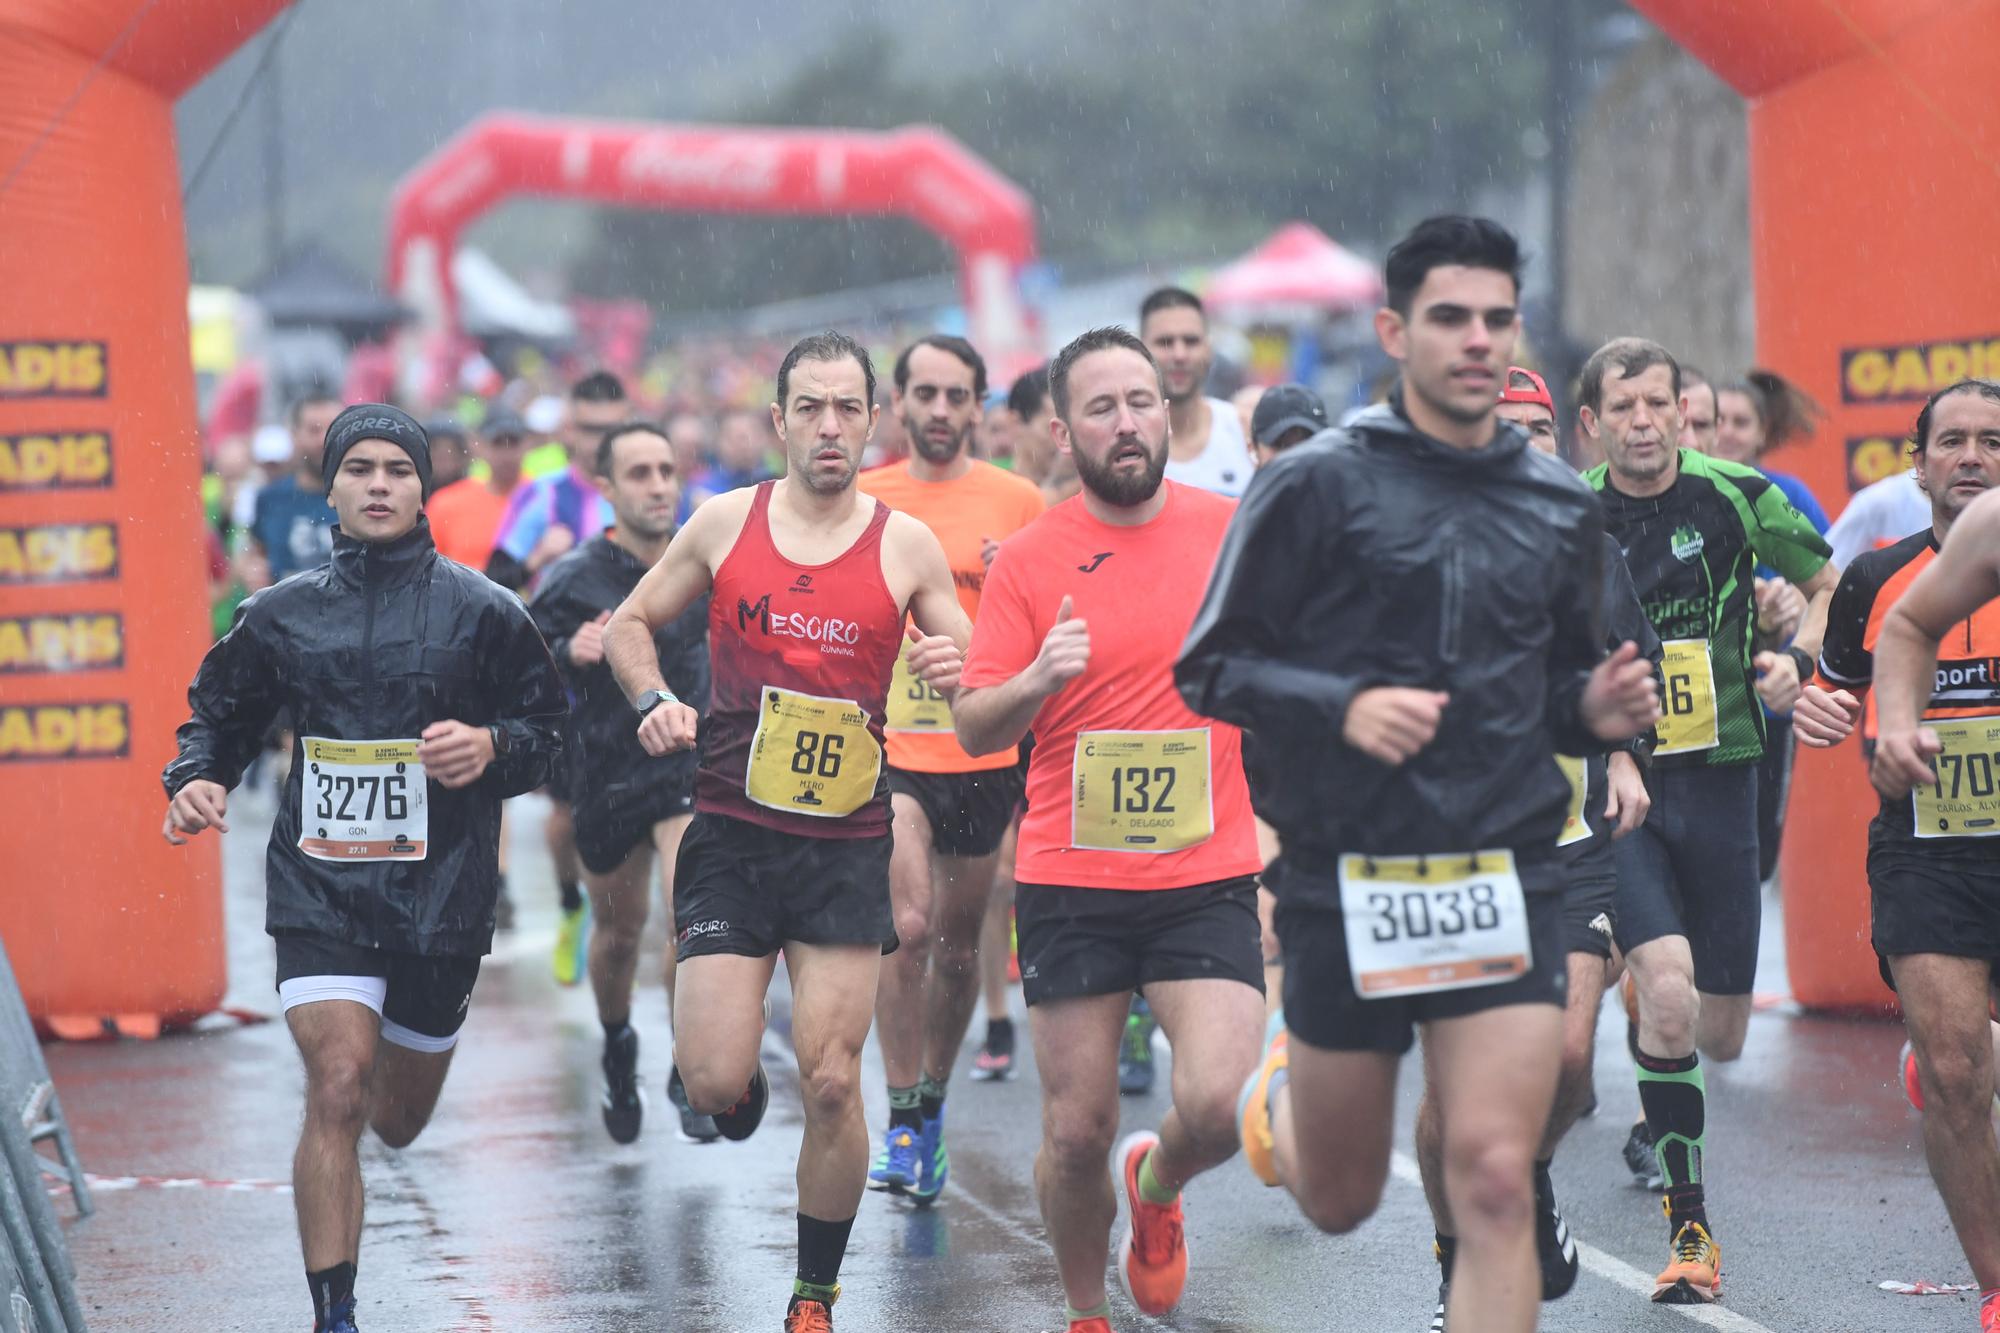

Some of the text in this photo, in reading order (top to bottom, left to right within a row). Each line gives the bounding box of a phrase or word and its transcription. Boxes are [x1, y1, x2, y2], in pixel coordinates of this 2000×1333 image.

[820, 644, 855, 657] RUNNING
[791, 730, 844, 778] 86
[800, 780, 824, 791] MIRO
[1111, 766, 1176, 813] 132
[1929, 752, 2000, 799] 170
[316, 774, 408, 821] 3276
[1936, 803, 1972, 813] CARLOS
[348, 827, 367, 836] GON
[1130, 818, 1175, 828] DELGADO
[1367, 883, 1500, 943] 3038
